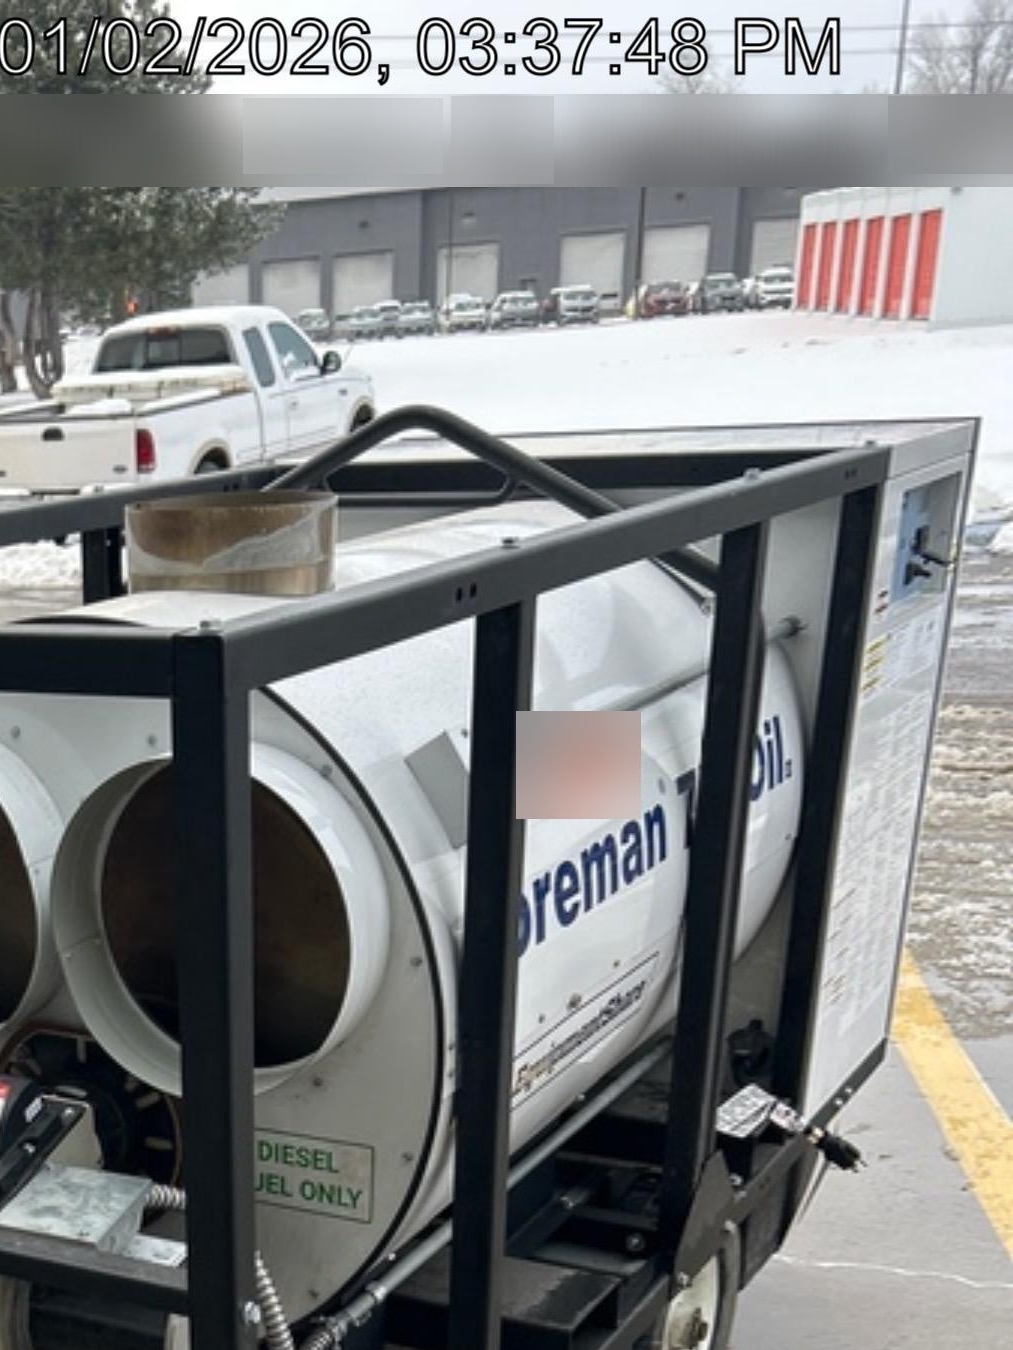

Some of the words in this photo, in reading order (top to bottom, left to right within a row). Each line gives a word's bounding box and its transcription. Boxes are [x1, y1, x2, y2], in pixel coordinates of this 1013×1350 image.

[516, 803, 667, 957] oreman
[258, 1141, 340, 1174] DIESEL
[254, 1172, 293, 1198] UEL
[299, 1180, 363, 1209] ONLY
